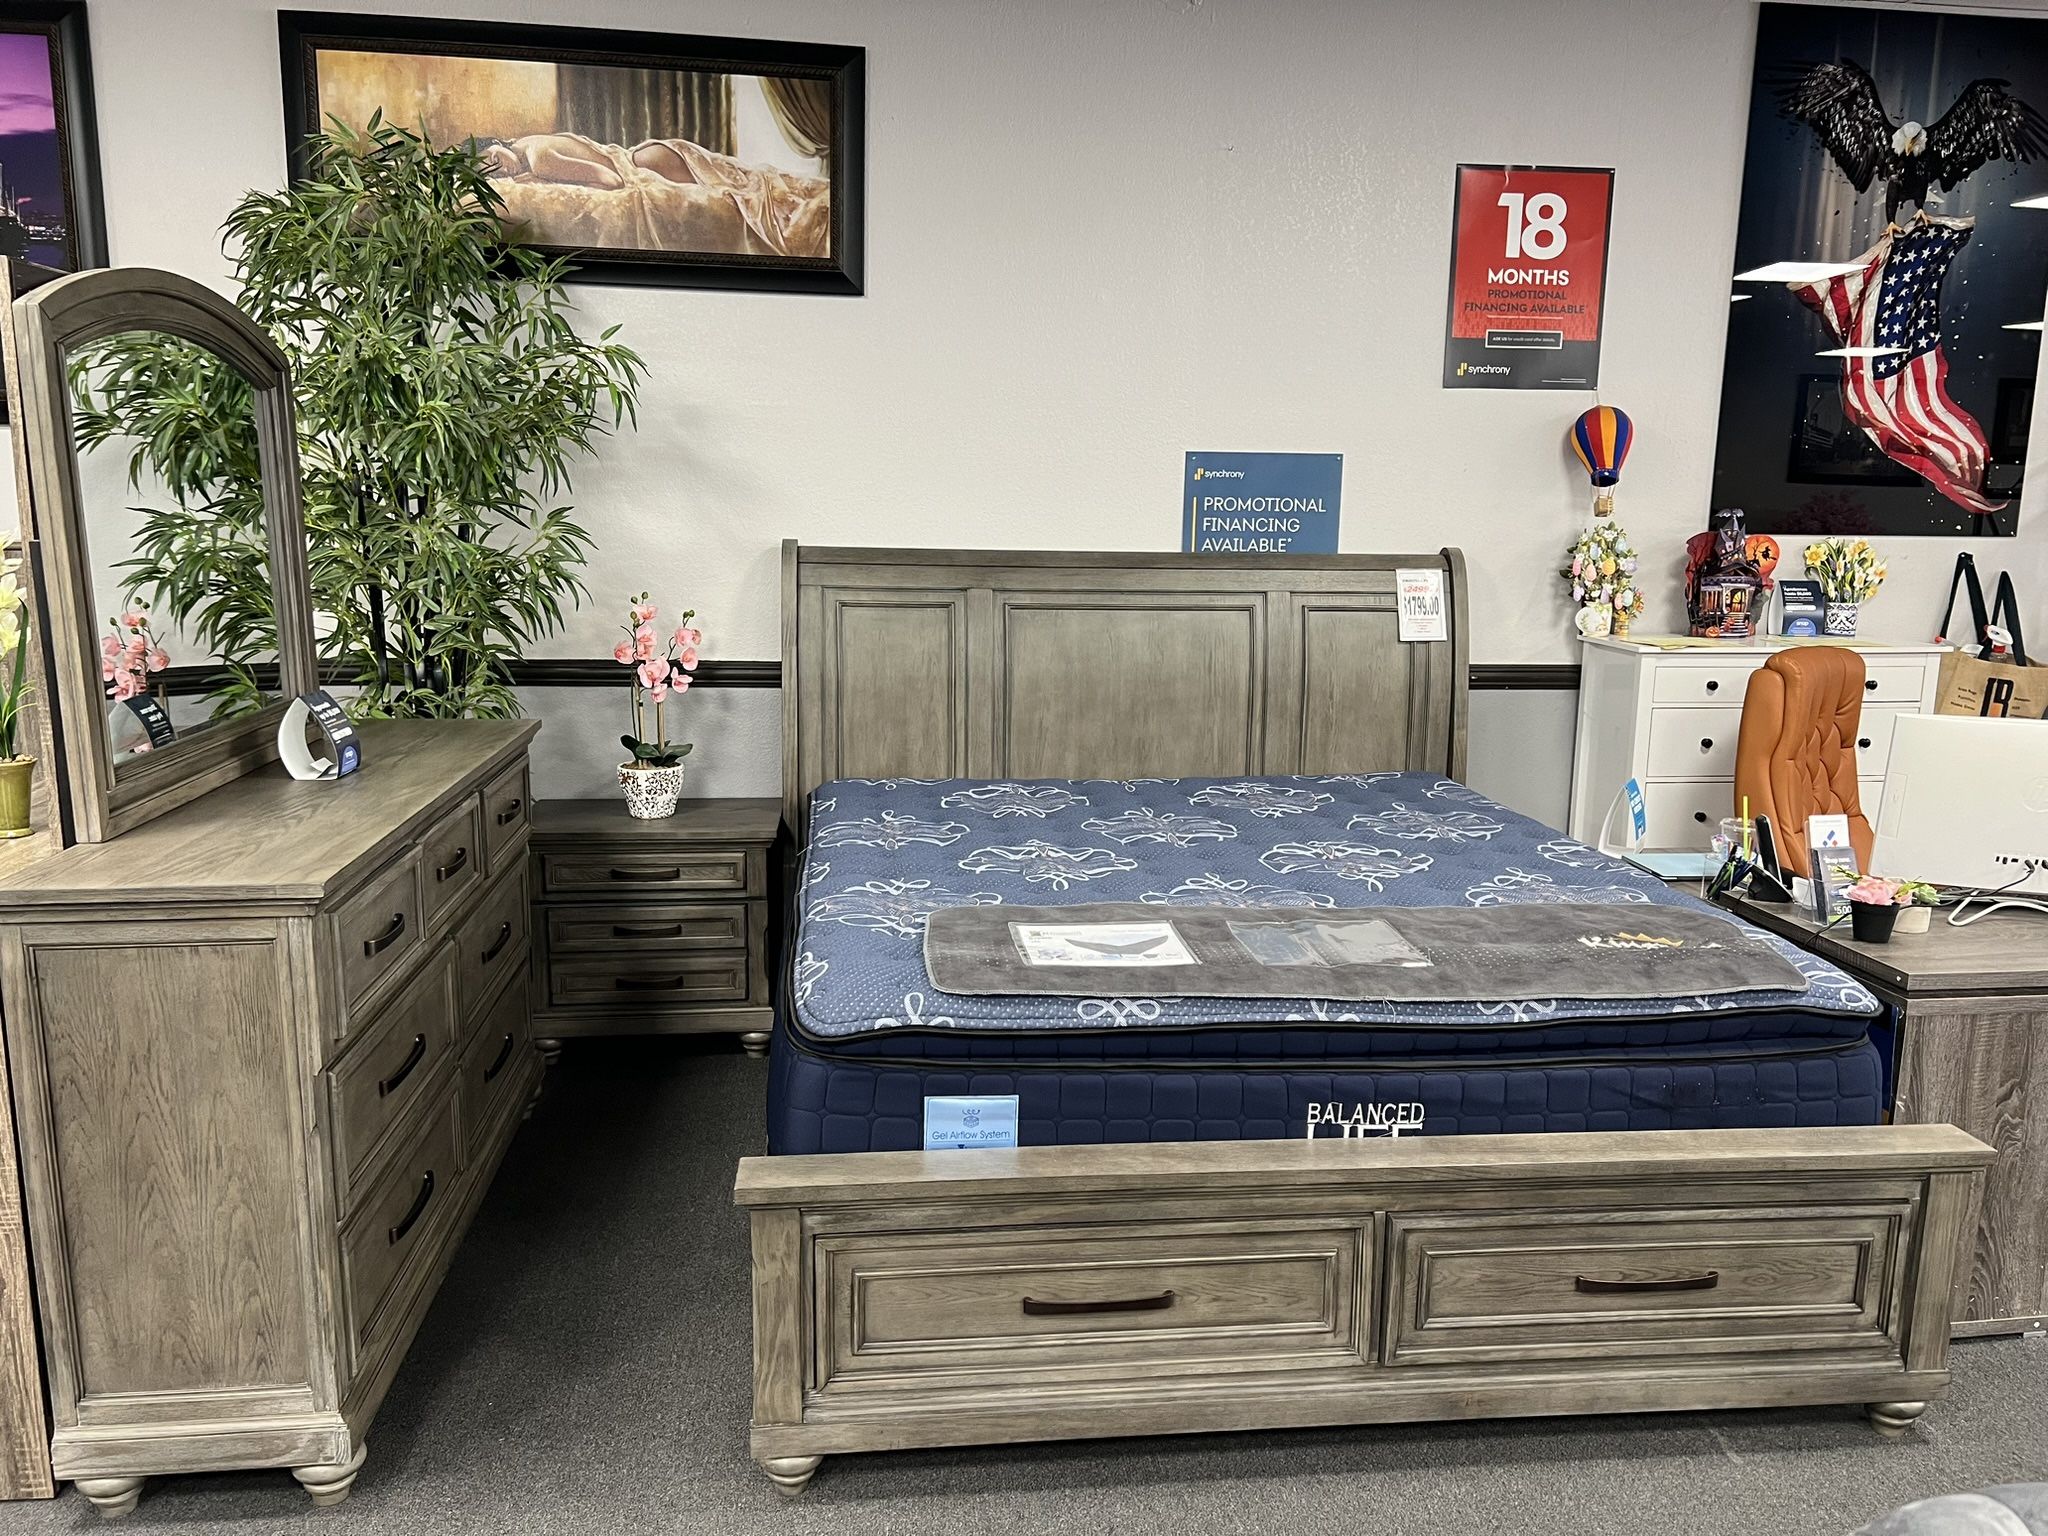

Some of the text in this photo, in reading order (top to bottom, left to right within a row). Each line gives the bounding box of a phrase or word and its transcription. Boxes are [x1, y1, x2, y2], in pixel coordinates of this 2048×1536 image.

[1497, 192, 1568, 260] 18
[1487, 267, 1570, 286] MONTHS
[1487, 289, 1567, 301] PROMOTIONAL
[1464, 302, 1528, 313] FINANCING
[1468, 364, 1512, 375] synchrony
[1204, 468, 1245, 480] synchrony
[1203, 496, 1327, 513] PROMOTIONAL
[1202, 517, 1301, 533] FINANCING
[1306, 1102, 1426, 1125] BALANCED
[931, 1129, 1010, 1140] Gel Airflow System
